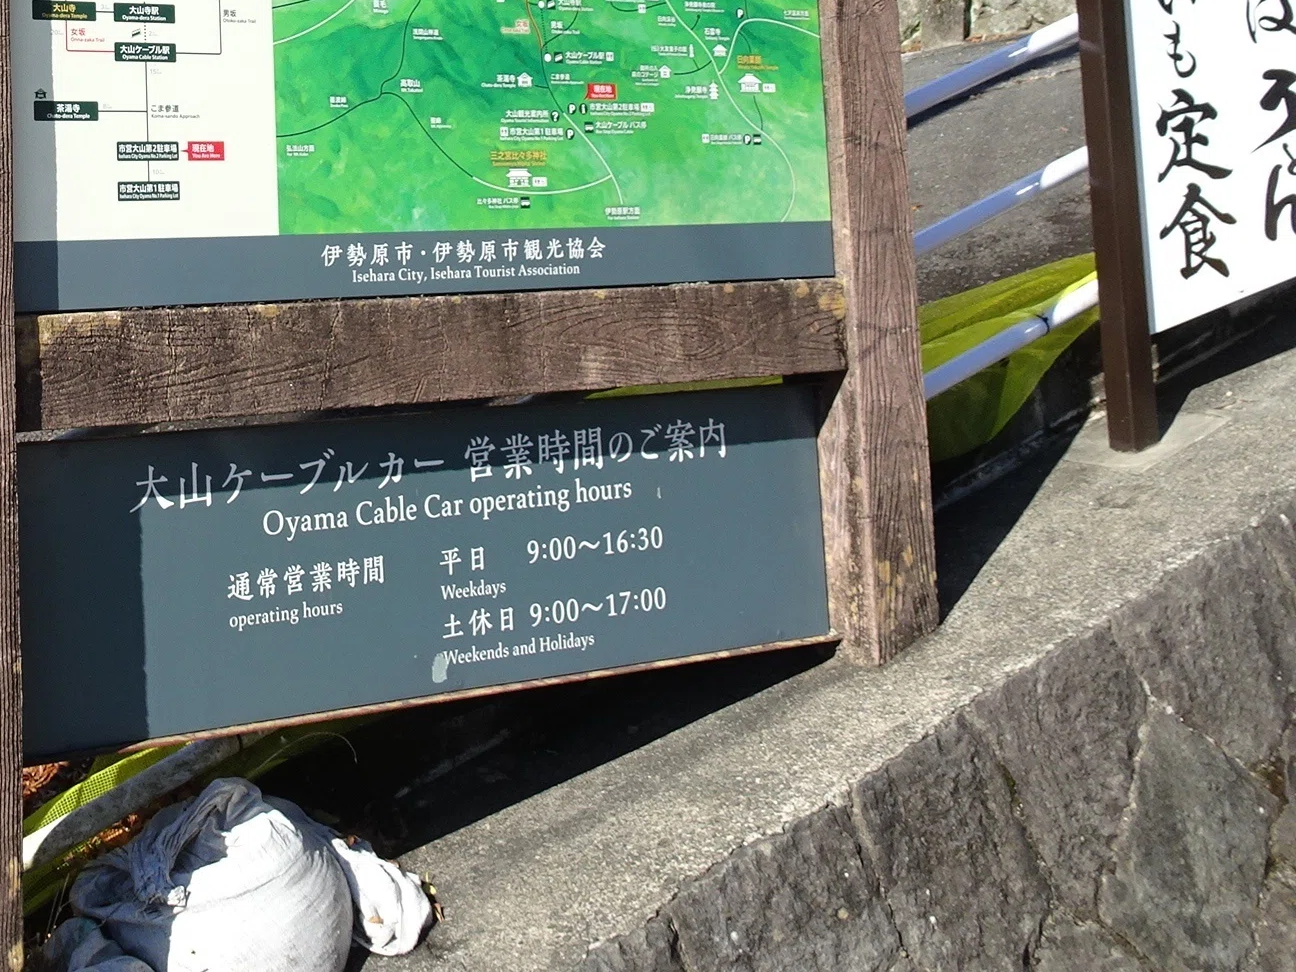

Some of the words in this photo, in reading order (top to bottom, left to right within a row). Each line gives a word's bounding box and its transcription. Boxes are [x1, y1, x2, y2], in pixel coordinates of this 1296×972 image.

[53, 3, 76, 13] 大山寺
[129, 6, 159, 16] 大山寺駅
[120, 45, 170, 55] 大山ケーブル駅
[192, 144, 214, 153] 現在地
[321, 236, 606, 268] 伊勢原市・伊勢原市観光協会
[352, 268, 395, 283] Isehara
[398, 267, 428, 284] City,
[431, 265, 471, 280] Isehara
[474, 264, 515, 278] Tourist
[518, 263, 580, 276] Association
[129, 448, 445, 513] 大山ケーブルカー
[464, 417, 727, 482] 営業時間のご案内
[263, 509, 348, 542] Oyama
[356, 495, 417, 526] Cable
[424, 493, 463, 518] Car
[469, 484, 570, 521] operating
[575, 478, 632, 504] hours
[440, 546, 485, 576] 平日
[227, 555, 385, 601] 通常営業時間
[441, 579, 507, 600] Weekdays
[229, 606, 300, 632] operating
[302, 601, 344, 619] hours
[442, 607, 514, 639] 土休日
[442, 641, 510, 666] Weekends
[512, 638, 536, 657] and
[540, 632, 595, 654] Holidays
